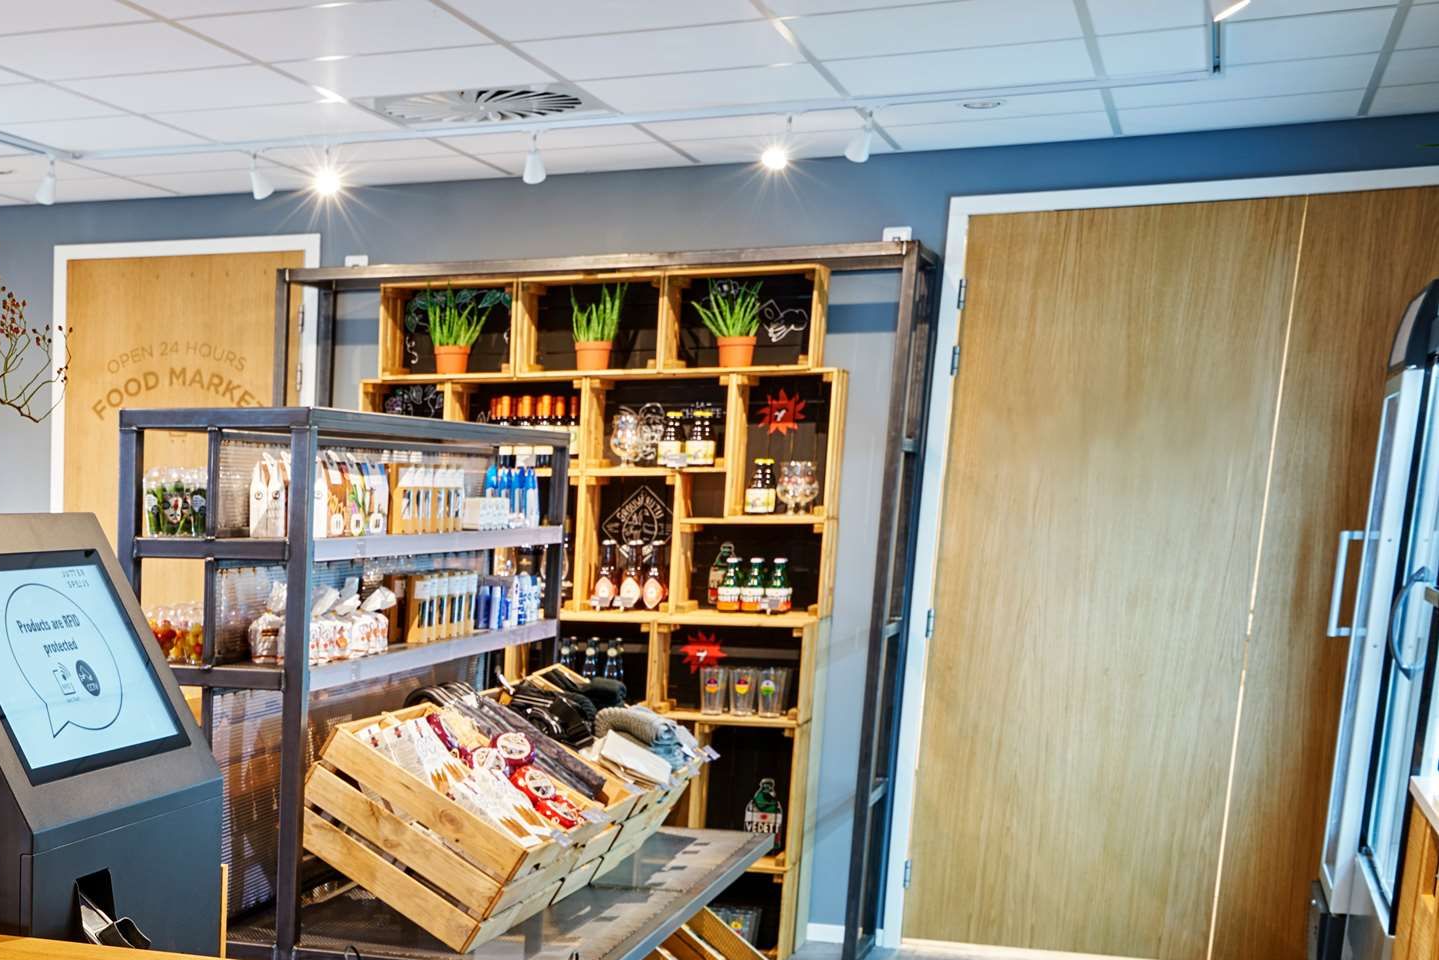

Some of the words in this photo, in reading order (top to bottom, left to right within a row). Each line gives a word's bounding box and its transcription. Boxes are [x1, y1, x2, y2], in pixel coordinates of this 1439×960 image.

[107, 345, 154, 374] OPEN
[160, 341, 179, 356] 24
[186, 341, 247, 372] HOURS
[92, 371, 159, 421] FOOD
[169, 367, 266, 408] MARKE
[16, 617, 52, 634] Products
[53, 619, 64, 631] are
[62, 614, 81, 629] RFID
[43, 639, 79, 657] protected
